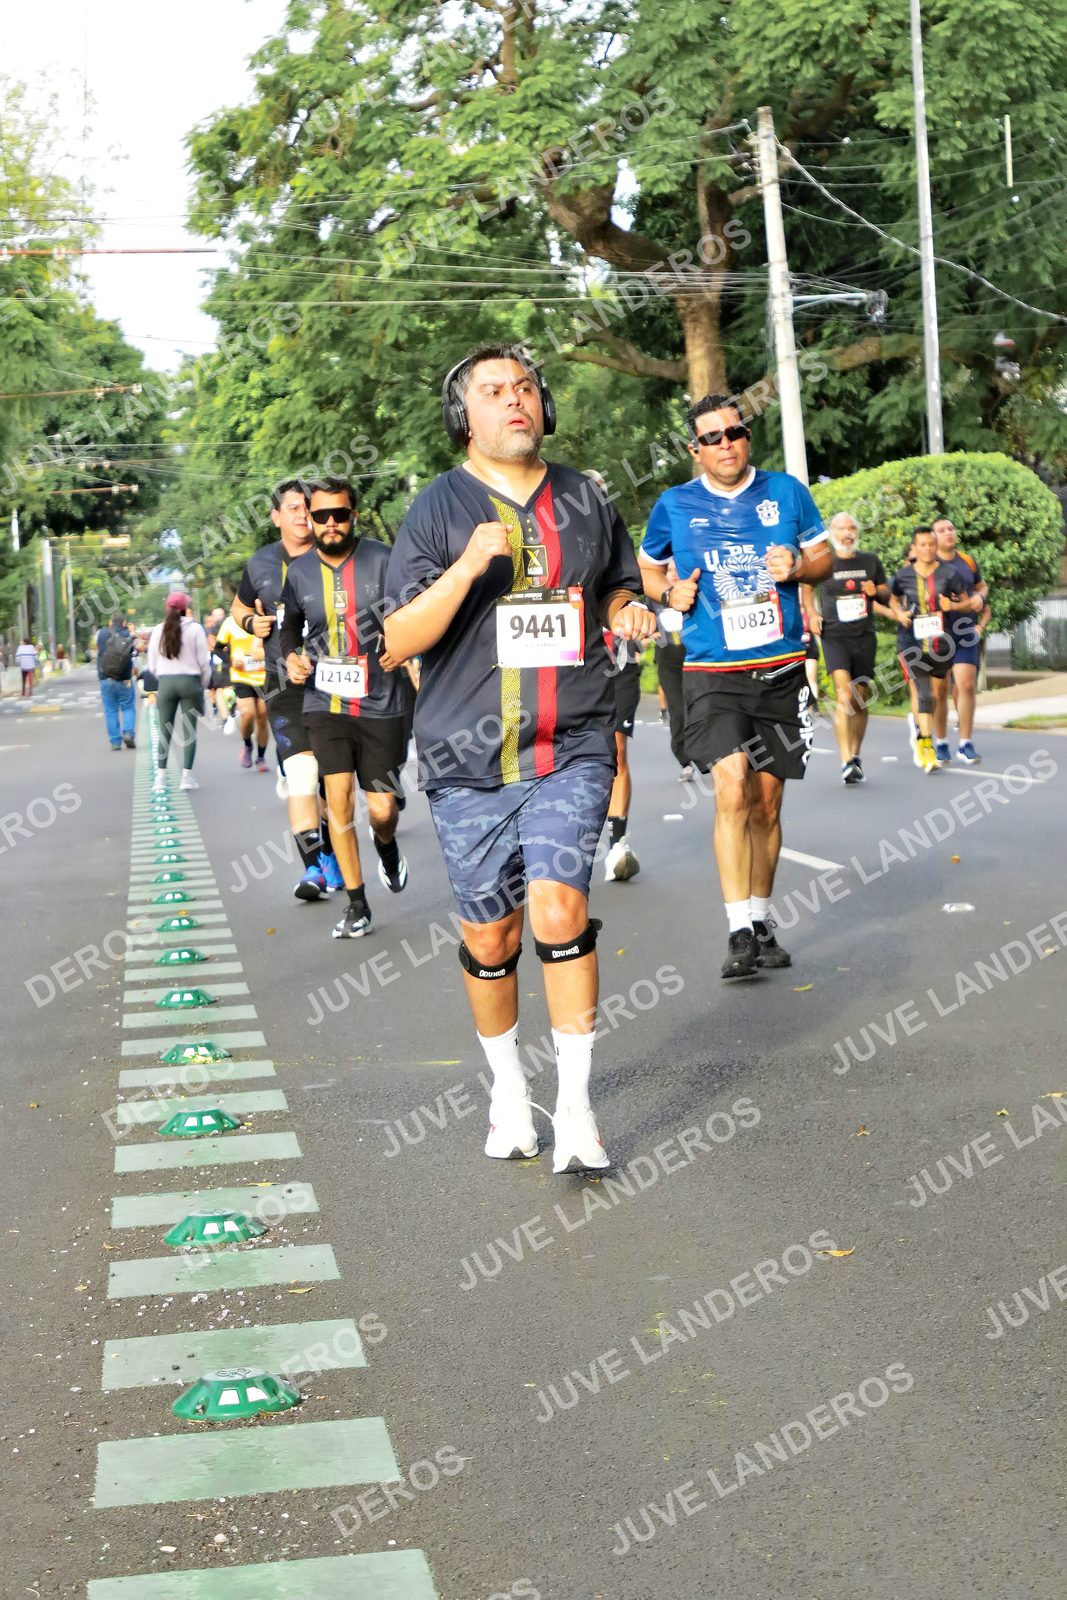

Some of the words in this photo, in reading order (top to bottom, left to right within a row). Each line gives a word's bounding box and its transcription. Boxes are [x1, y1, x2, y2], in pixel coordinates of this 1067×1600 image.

[704, 550, 720, 572] U
[727, 545, 757, 556] DE
[510, 614, 566, 639] 9441
[727, 608, 775, 631] 10823
[320, 671, 360, 683] 12142
